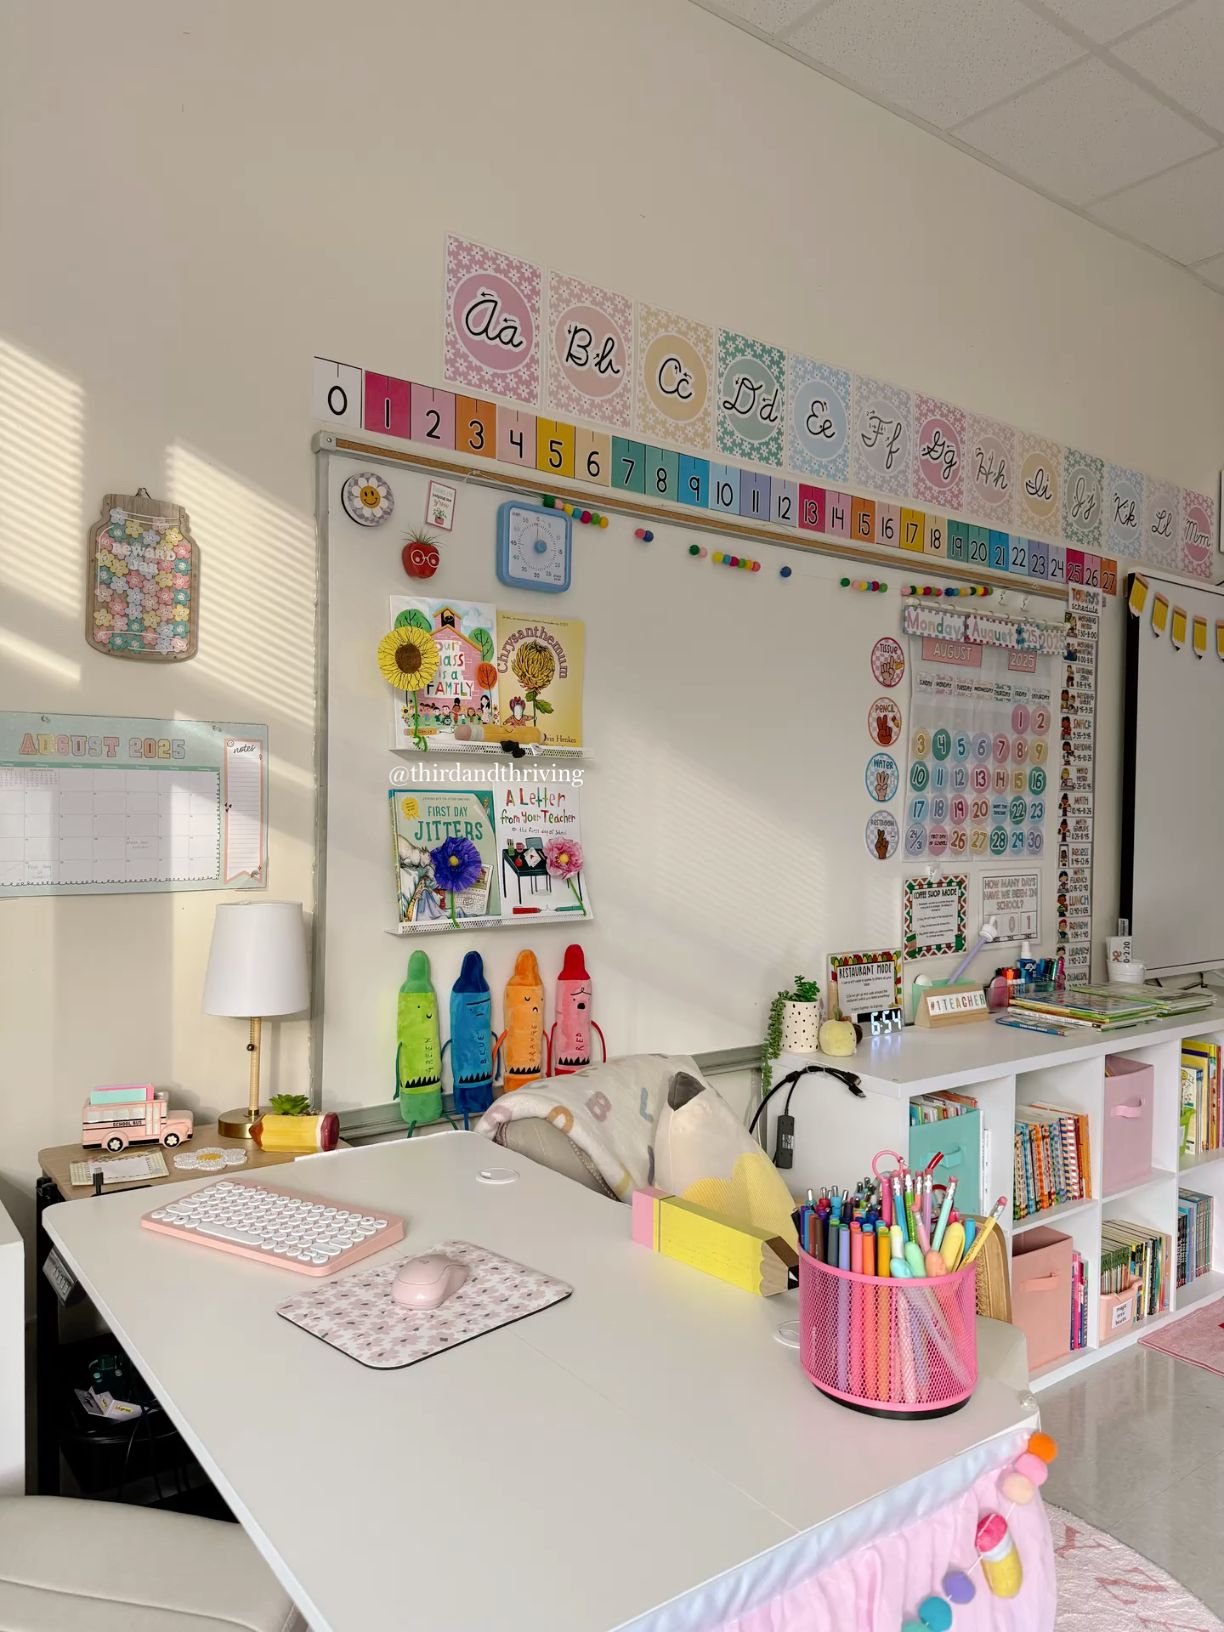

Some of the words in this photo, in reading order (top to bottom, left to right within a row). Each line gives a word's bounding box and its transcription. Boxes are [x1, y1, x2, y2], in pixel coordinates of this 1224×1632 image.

[465, 298, 523, 348] Aa
[566, 325, 620, 374] Bb
[659, 358, 692, 399] Cc
[723, 377, 778, 422] Dd
[806, 400, 835, 438] Ee
[861, 416, 901, 469] Ff
[921, 431, 957, 480] Gg
[975, 451, 1008, 489] Hh
[1026, 468, 1053, 500] Ii
[1072, 477, 1096, 520] Jj
[1113, 496, 1137, 528] Kk
[1151, 510, 1172, 538] Ll
[1184, 519, 1211, 548] Mm
[328, 386, 347, 415] 0
[384, 399, 391, 428] 1
[426, 410, 440, 438] 2
[469, 420, 484, 449] 3
[510, 429, 523, 458] 4
[549, 440, 563, 468] 5
[587, 451, 600, 477] 6
[622, 459, 635, 484] 7
[656, 467, 667, 492] 8
[689, 476, 700, 501] 9
[716, 482, 733, 507] 10
[752, 490, 759, 513] 11
[778, 496, 791, 520] 12
[804, 501, 818, 524] 13
[832, 507, 844, 529] 14
[858, 513, 870, 536] 15
[881, 517, 894, 539] 16
[906, 523, 918, 543] 17
[930, 528, 941, 549] 18
[952, 535, 962, 557] 19
[970, 541, 987, 562] 20
[995, 546, 1005, 566] 21
[1012, 546, 1026, 567] 22
[1031, 554, 1046, 575] 23
[1051, 558, 1064, 578] 24
[1068, 564, 1081, 584] 25
[1085, 567, 1098, 587] 26
[1102, 572, 1115, 590] 27
[1072, 603, 1098, 614] schedule
[906, 611, 962, 638] Monday
[972, 621, 1014, 643] August
[497, 626, 568, 679] Chrysanthemum
[933, 644, 972, 660] AUGUST
[1011, 652, 1035, 668] 2025
[426, 681, 474, 696] FAMILY
[875, 704, 895, 713] PENCIL
[1019, 711, 1023, 727] 1
[1037, 712, 1044, 728] 2
[19, 733, 120, 758] AUGUST
[128, 737, 186, 759] 2025
[233, 744, 256, 754] notes
[917, 735, 925, 753] 3
[938, 735, 946, 753] 4
[958, 738, 966, 756] 5
[978, 739, 986, 756] 6
[998, 740, 1005, 756] 7
[1017, 741, 1024, 758] 8
[1036, 743, 1043, 760] 9
[873, 760, 894, 770] WATER
[913, 764, 926, 785] 10
[937, 768, 943, 786] 11
[955, 768, 964, 786] 12
[975, 769, 987, 787] 13
[996, 771, 1005, 788] 14
[1014, 772, 1023, 789] 15
[1032, 771, 1042, 790] 16
[506, 789, 515, 806] A
[519, 787, 566, 808] Letter
[427, 805, 451, 816] FIRST
[454, 805, 468, 817] DAY
[500, 808, 520, 824] from
[540, 809, 576, 823] Teacher
[913, 801, 925, 818] 17
[934, 800, 944, 817] 18
[954, 800, 964, 817] 19
[972, 801, 988, 819] 20
[1012, 803, 1024, 819] 22
[1030, 803, 1043, 819] 23
[414, 820, 483, 841] JITTERS
[951, 830, 966, 849] 26
[971, 831, 987, 849] 27
[992, 831, 1006, 849] 28
[1012, 832, 1024, 848] 29
[1028, 832, 1041, 849] 30
[984, 880, 1000, 889] HOW
[1000, 878, 1020, 888] MANY
[1021, 877, 1036, 887] DAYS
[928, 889, 941, 898] SHOP
[942, 888, 957, 896] MODE
[984, 890, 1000, 900] HAVE
[1001, 889, 1010, 899] WE
[1069, 895, 1089, 906] LUNCH
[996, 900, 1024, 910] SCHOOL?
[1008, 916, 1016, 933] 0
[1026, 915, 1031, 930] 1
[839, 964, 874, 979] RESTAURANT
[876, 963, 892, 974] MODE
[870, 1010, 902, 1036] 6:54
[479, 1032, 487, 1065] BLUE
[529, 1024, 538, 1063] ORANGE
[575, 1032, 584, 1051] RED
[425, 1038, 434, 1075] GREEN
